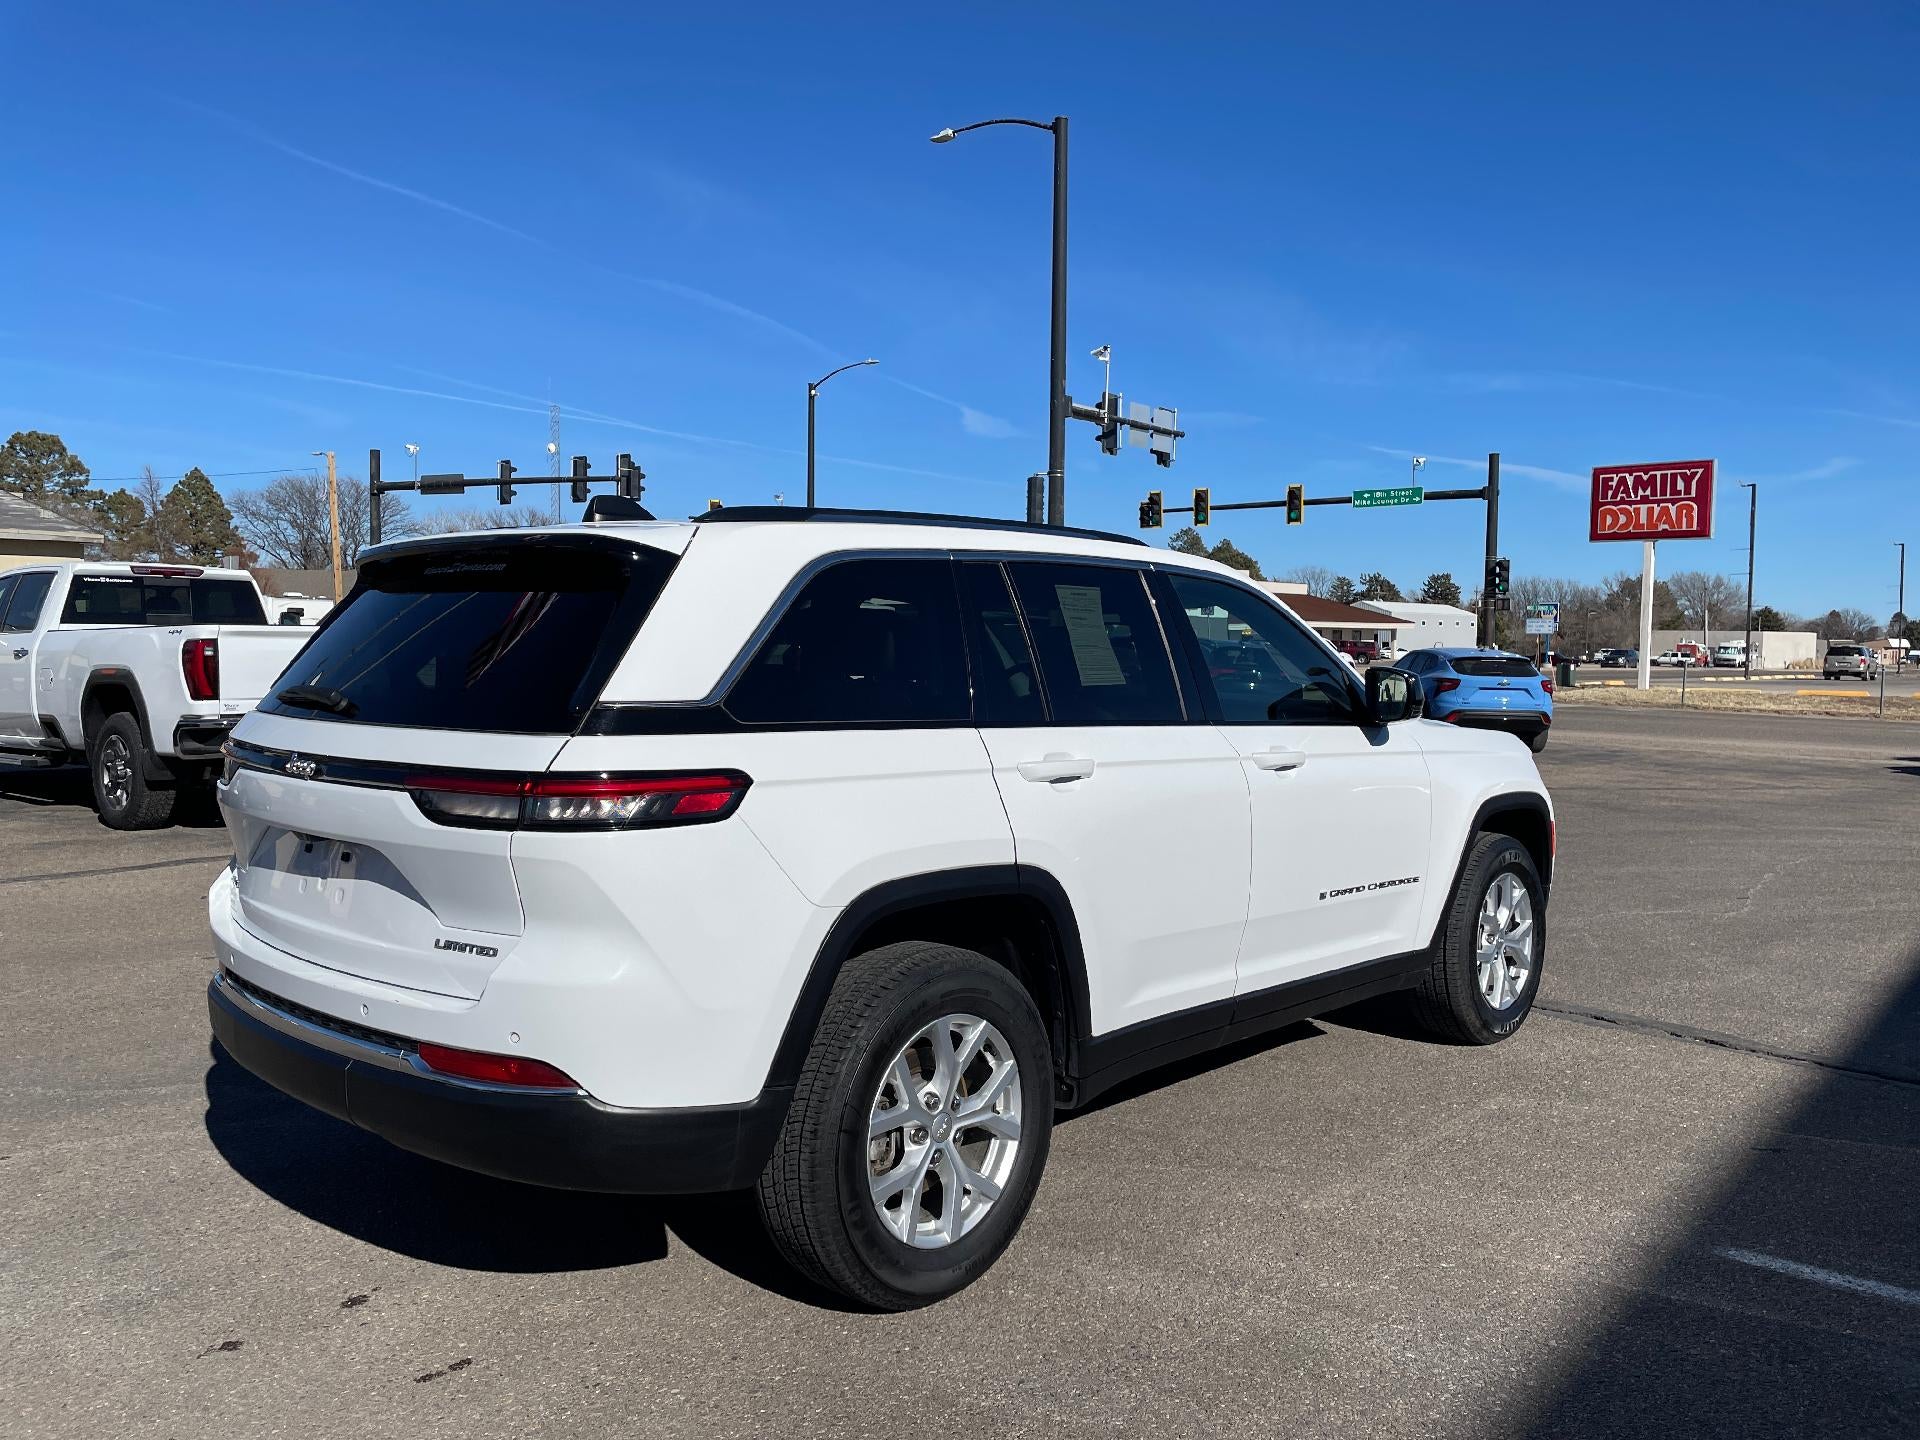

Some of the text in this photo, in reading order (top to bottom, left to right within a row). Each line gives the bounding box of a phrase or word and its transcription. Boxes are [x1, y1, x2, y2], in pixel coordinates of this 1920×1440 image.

[1390, 489, 1413, 497] Street
[1599, 468, 1704, 502] FAMILY
[1598, 500, 1698, 534] DOLLAR
[285, 753, 316, 781] Jeep
[1329, 876, 1420, 898] GRAND CHEROKEE
[434, 938, 499, 958] LIMITED
